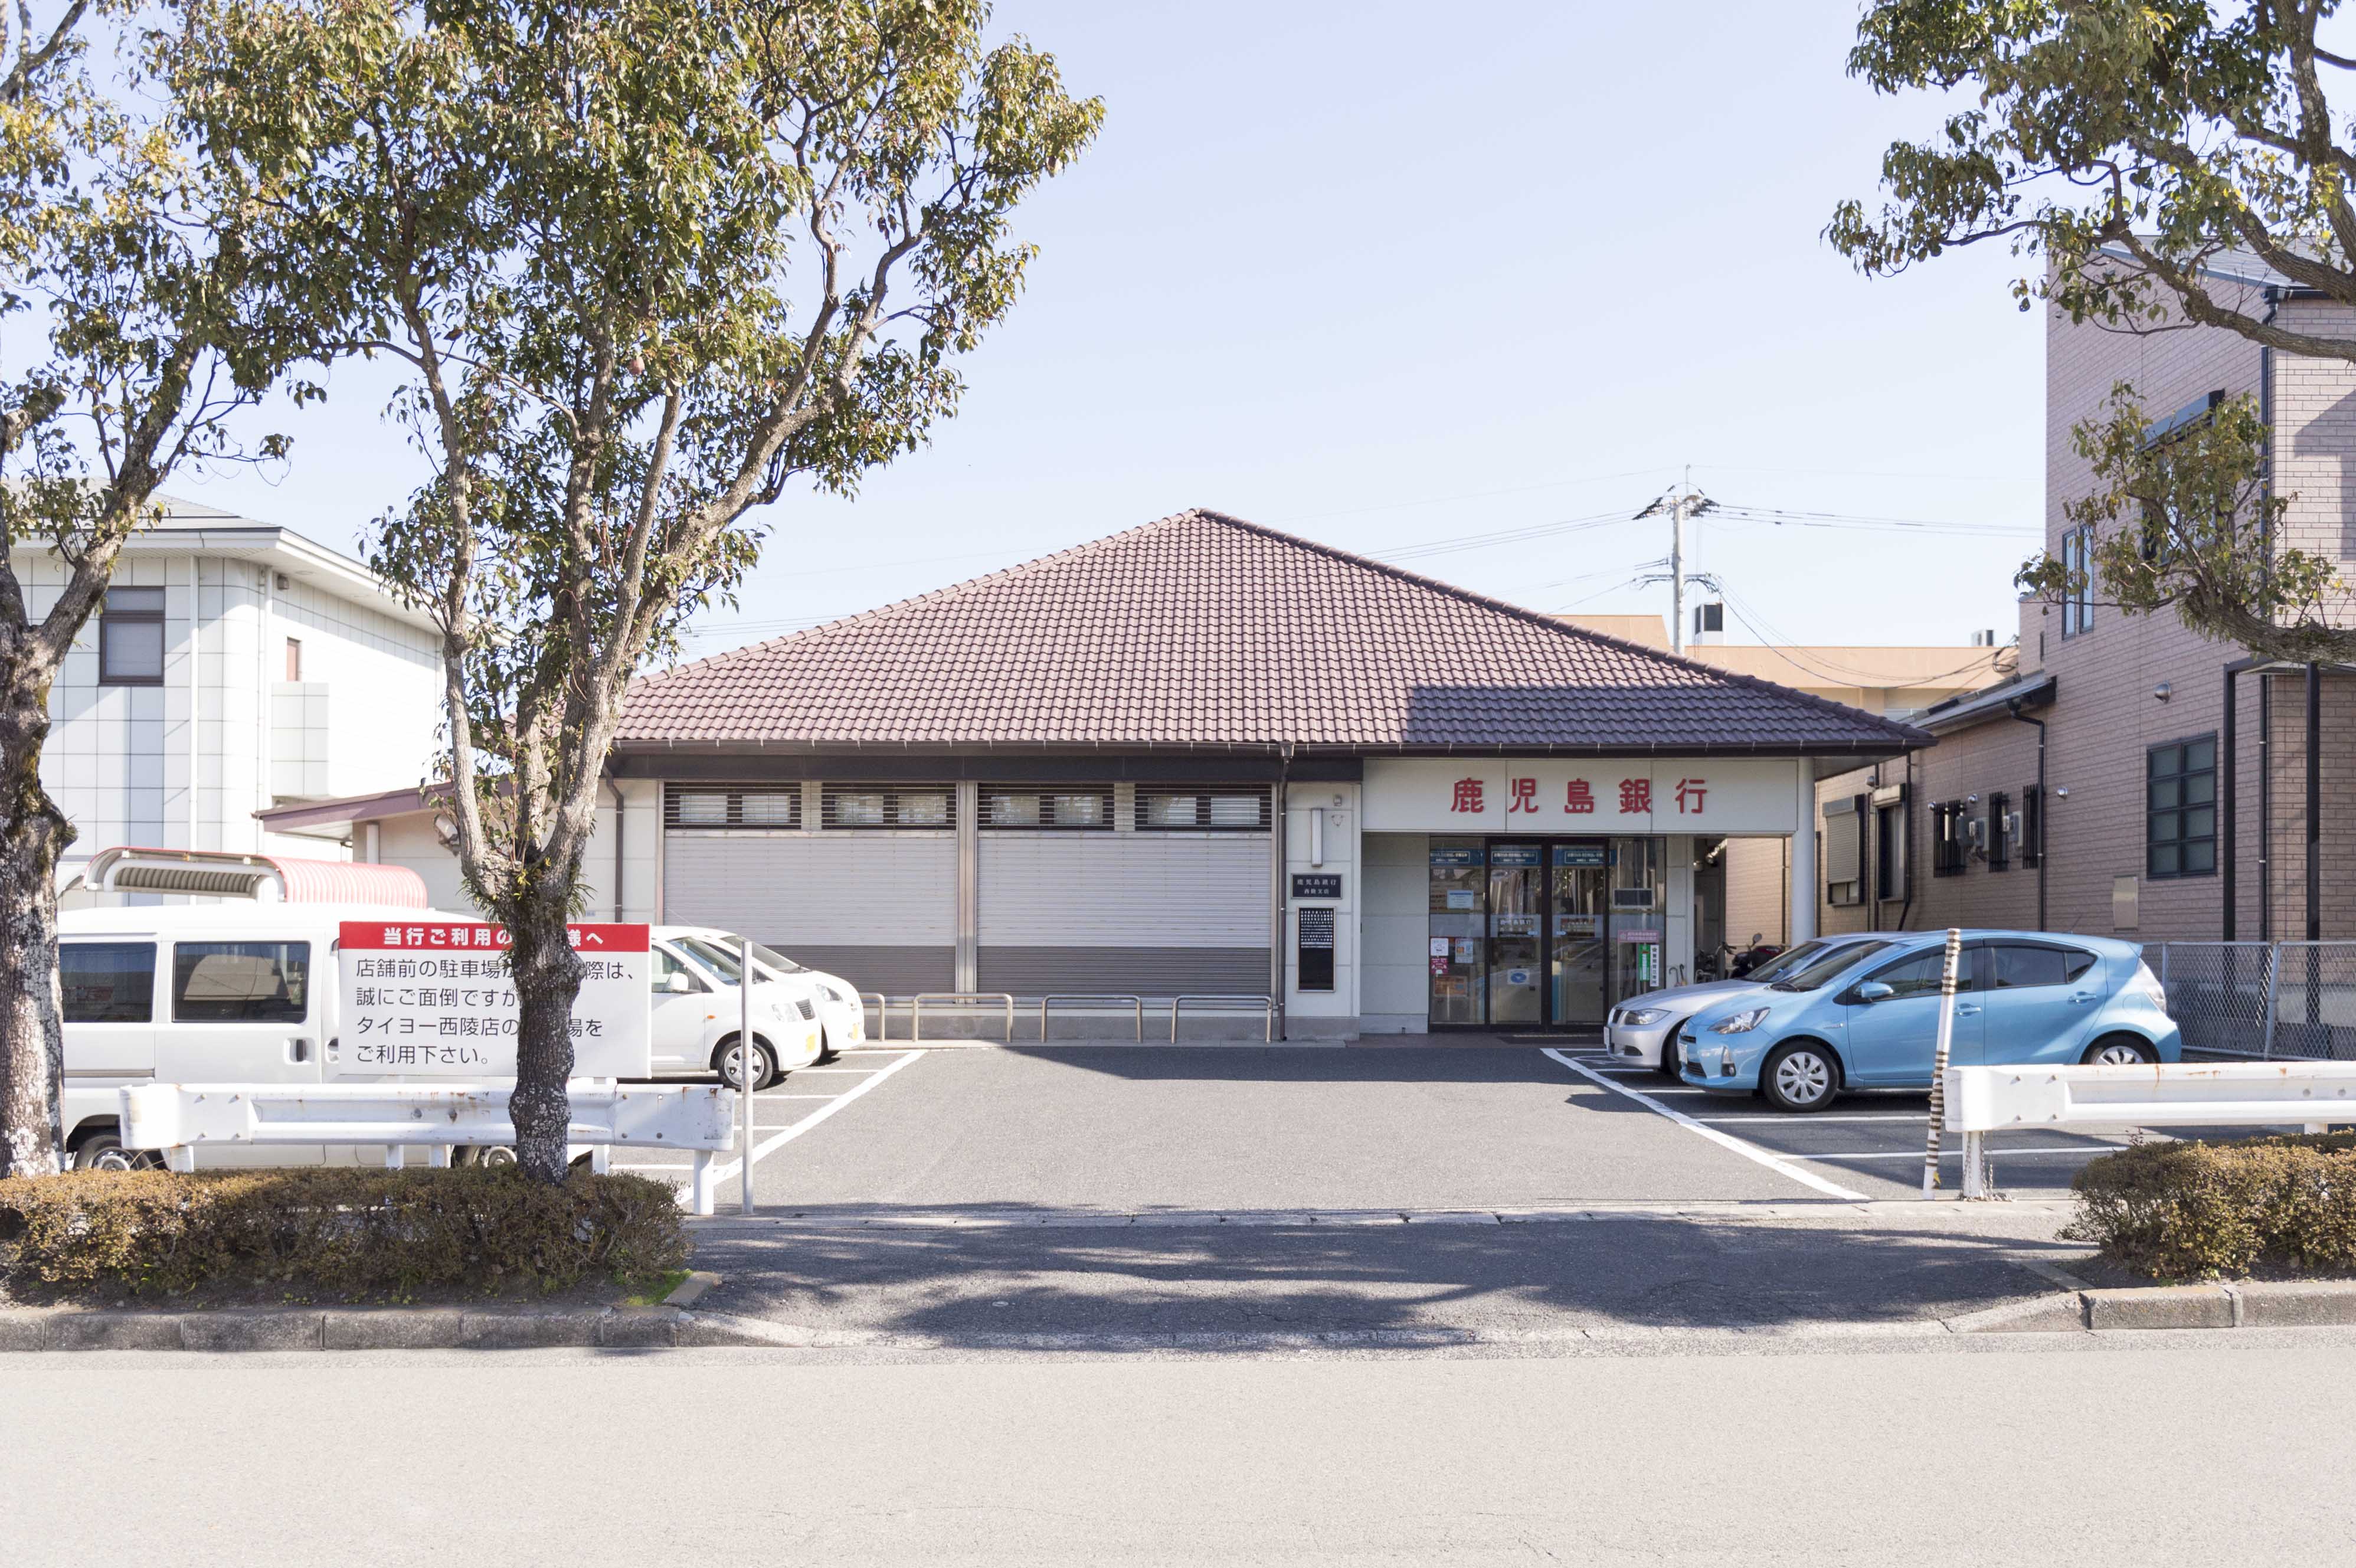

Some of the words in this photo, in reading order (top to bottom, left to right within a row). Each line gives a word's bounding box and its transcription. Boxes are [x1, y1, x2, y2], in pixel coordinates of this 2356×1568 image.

[1451, 777, 1707, 814] 鹿児島銀行
[384, 928, 603, 947] 当行ご利用の様へ
[356, 958, 633, 980] 店舗前の駐車場際は、
[357, 1016, 603, 1037] タイヨー西陵店の場を
[358, 1045, 487, 1064] ご利用下さい。
